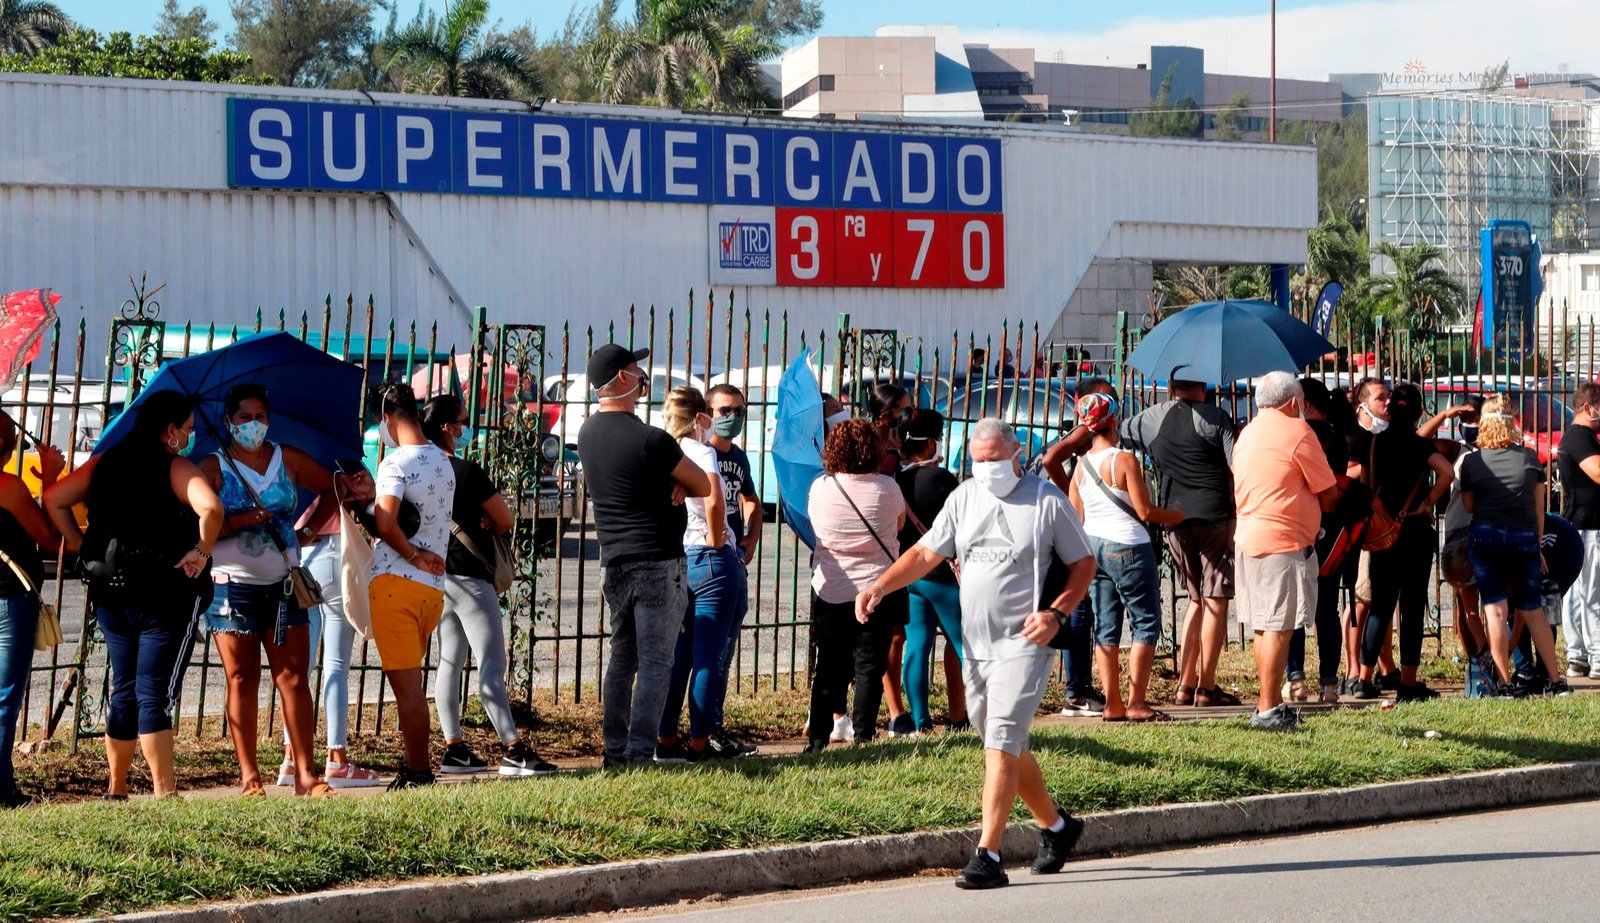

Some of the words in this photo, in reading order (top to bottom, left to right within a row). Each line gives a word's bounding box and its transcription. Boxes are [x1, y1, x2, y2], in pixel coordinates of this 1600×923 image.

[1382, 72, 1454, 84] Memories
[249, 108, 991, 206] SUPERMERCADO
[742, 226, 770, 252] TRD
[870, 253, 882, 282] y
[907, 219, 991, 282] 70
[743, 256, 770, 267] CARIBE
[964, 547, 1019, 564] Reebok
